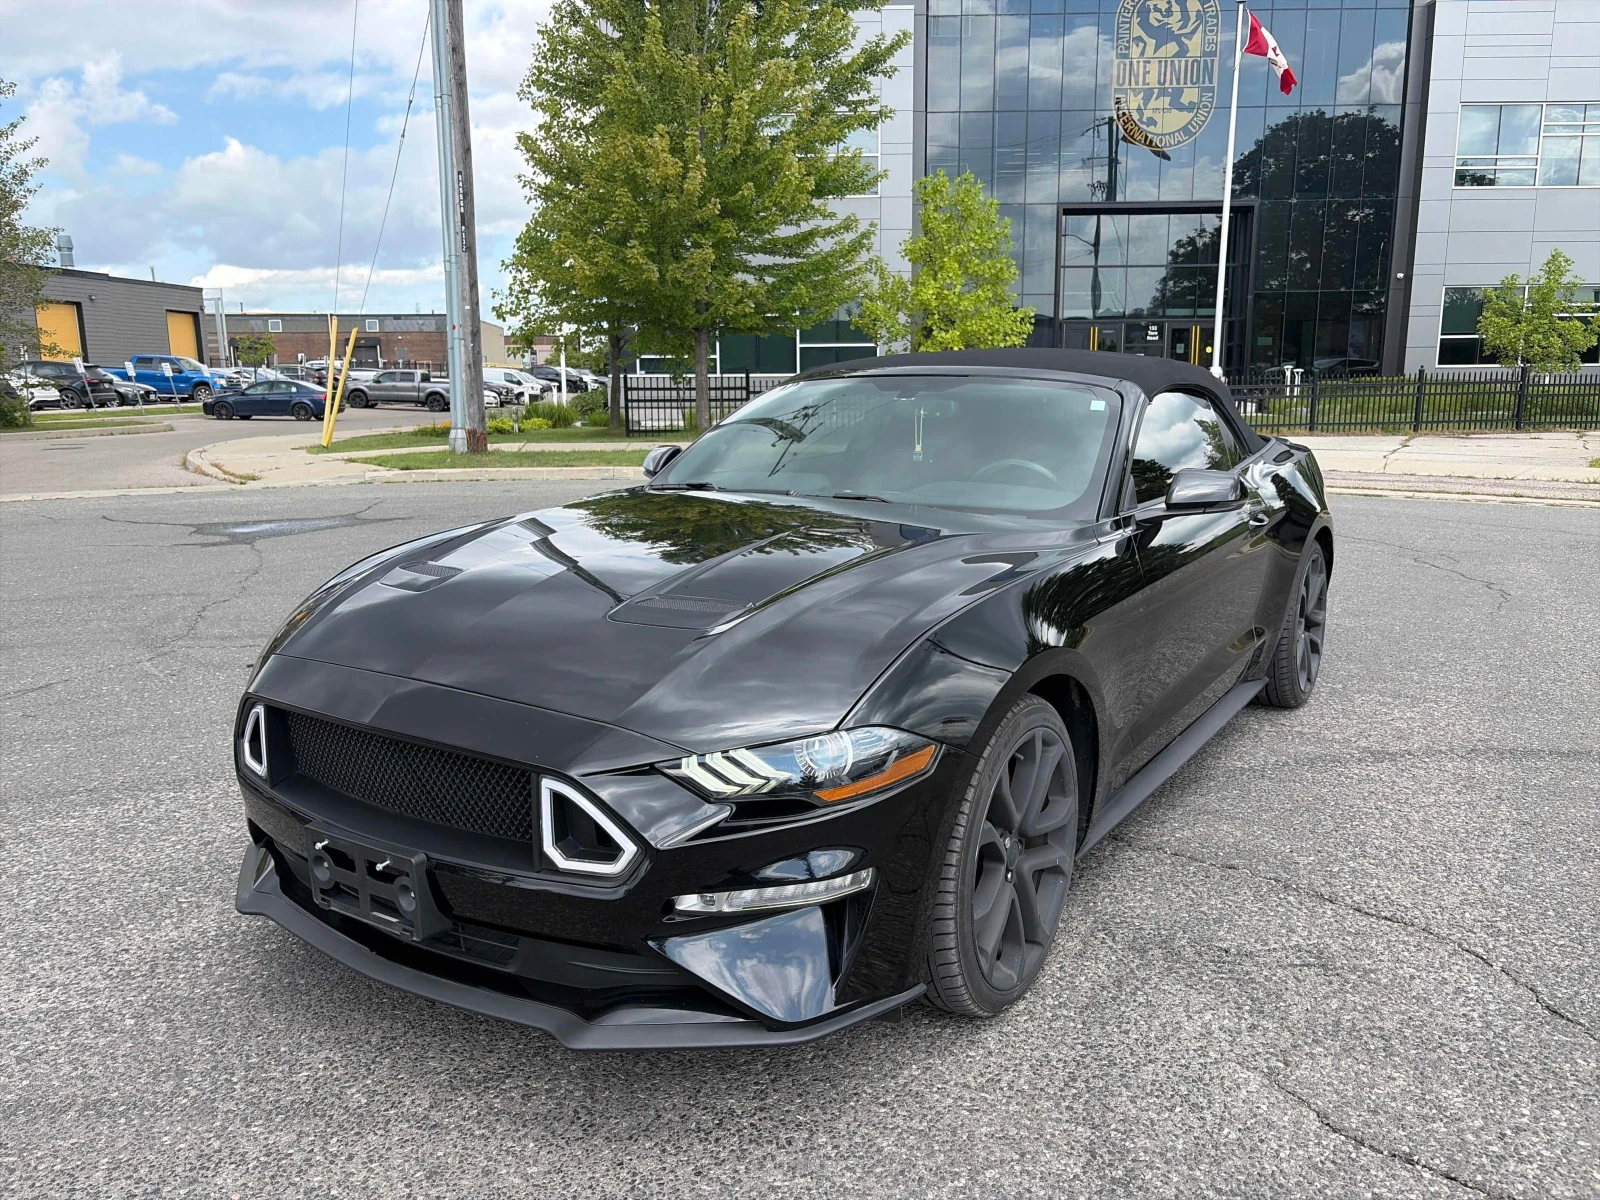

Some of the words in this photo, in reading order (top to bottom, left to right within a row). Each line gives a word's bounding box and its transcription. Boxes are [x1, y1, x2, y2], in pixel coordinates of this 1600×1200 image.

[1117, 0, 1136, 54] PAINTER
[1203, 0, 1217, 52] TRADES
[1116, 60, 1151, 87] ONE
[1157, 59, 1215, 86] UNION
[1114, 94, 1189, 147] INTERNATIONAL
[1187, 92, 1213, 133] UNION
